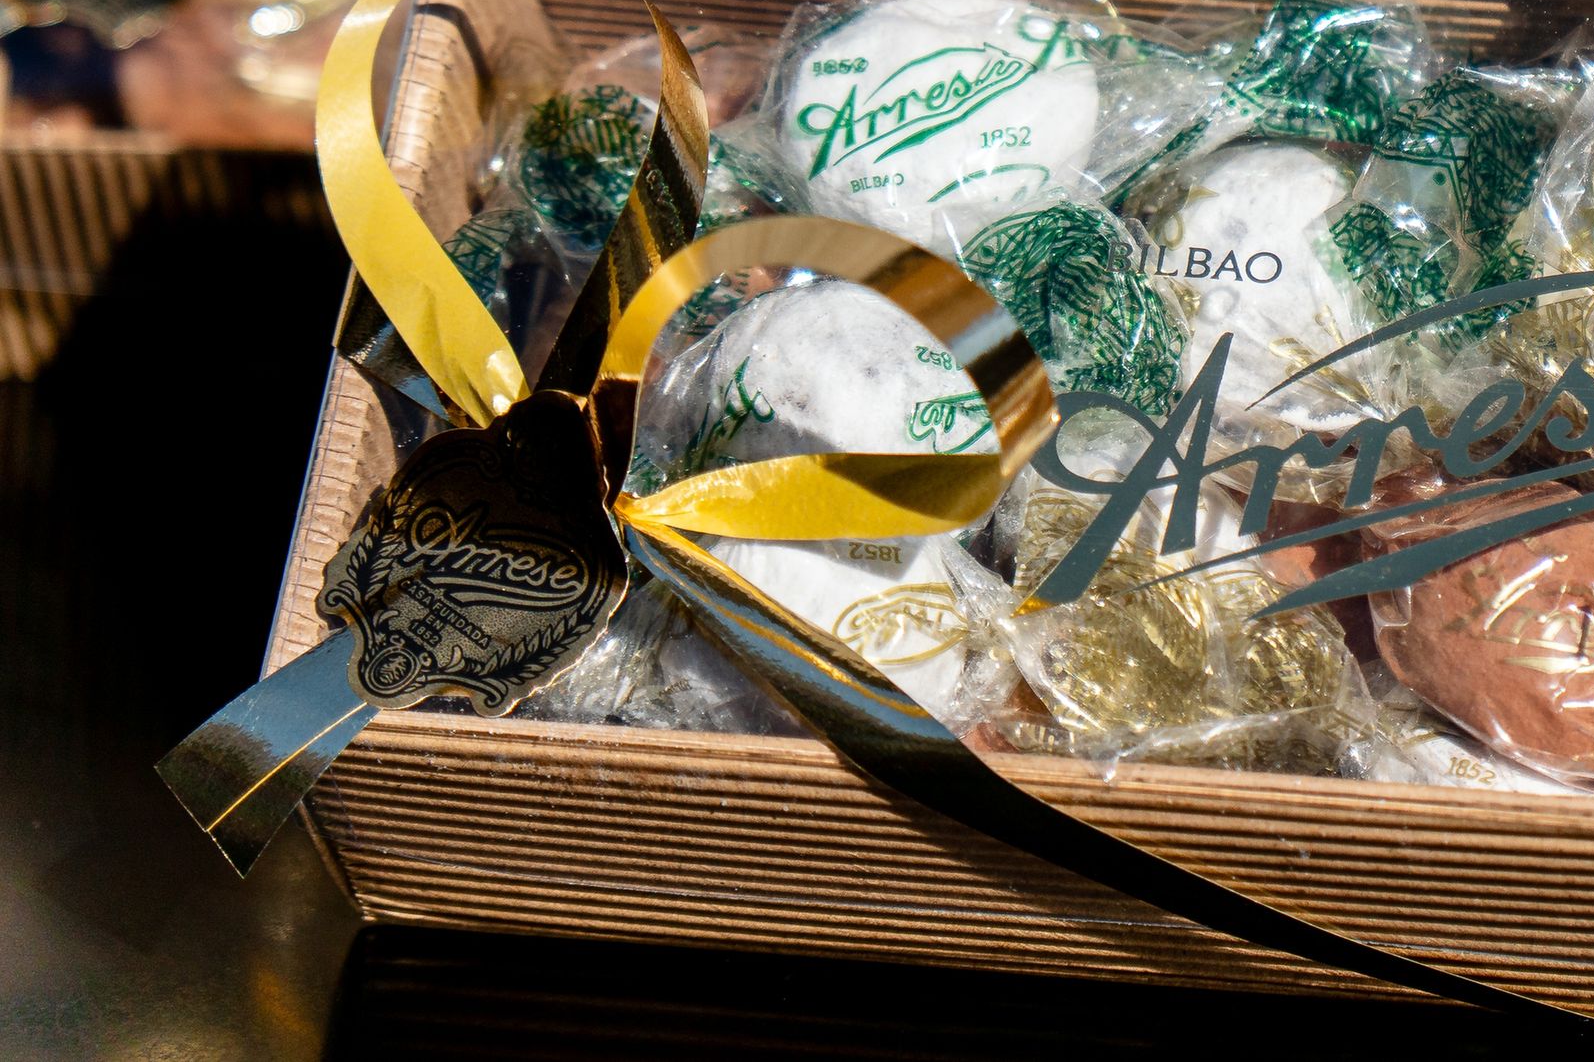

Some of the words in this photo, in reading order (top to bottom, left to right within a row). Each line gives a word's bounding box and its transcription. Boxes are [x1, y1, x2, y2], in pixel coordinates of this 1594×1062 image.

[1108, 242, 1283, 284] BILBAO
[913, 345, 966, 371] 852
[403, 504, 588, 604] Arrese
[848, 541, 903, 564] 1852
[400, 578, 433, 606] CASA
[431, 601, 490, 648] FUNDADA
[425, 614, 445, 631] EN
[410, 621, 441, 646] 1852
[1448, 756, 1497, 785] 1852
